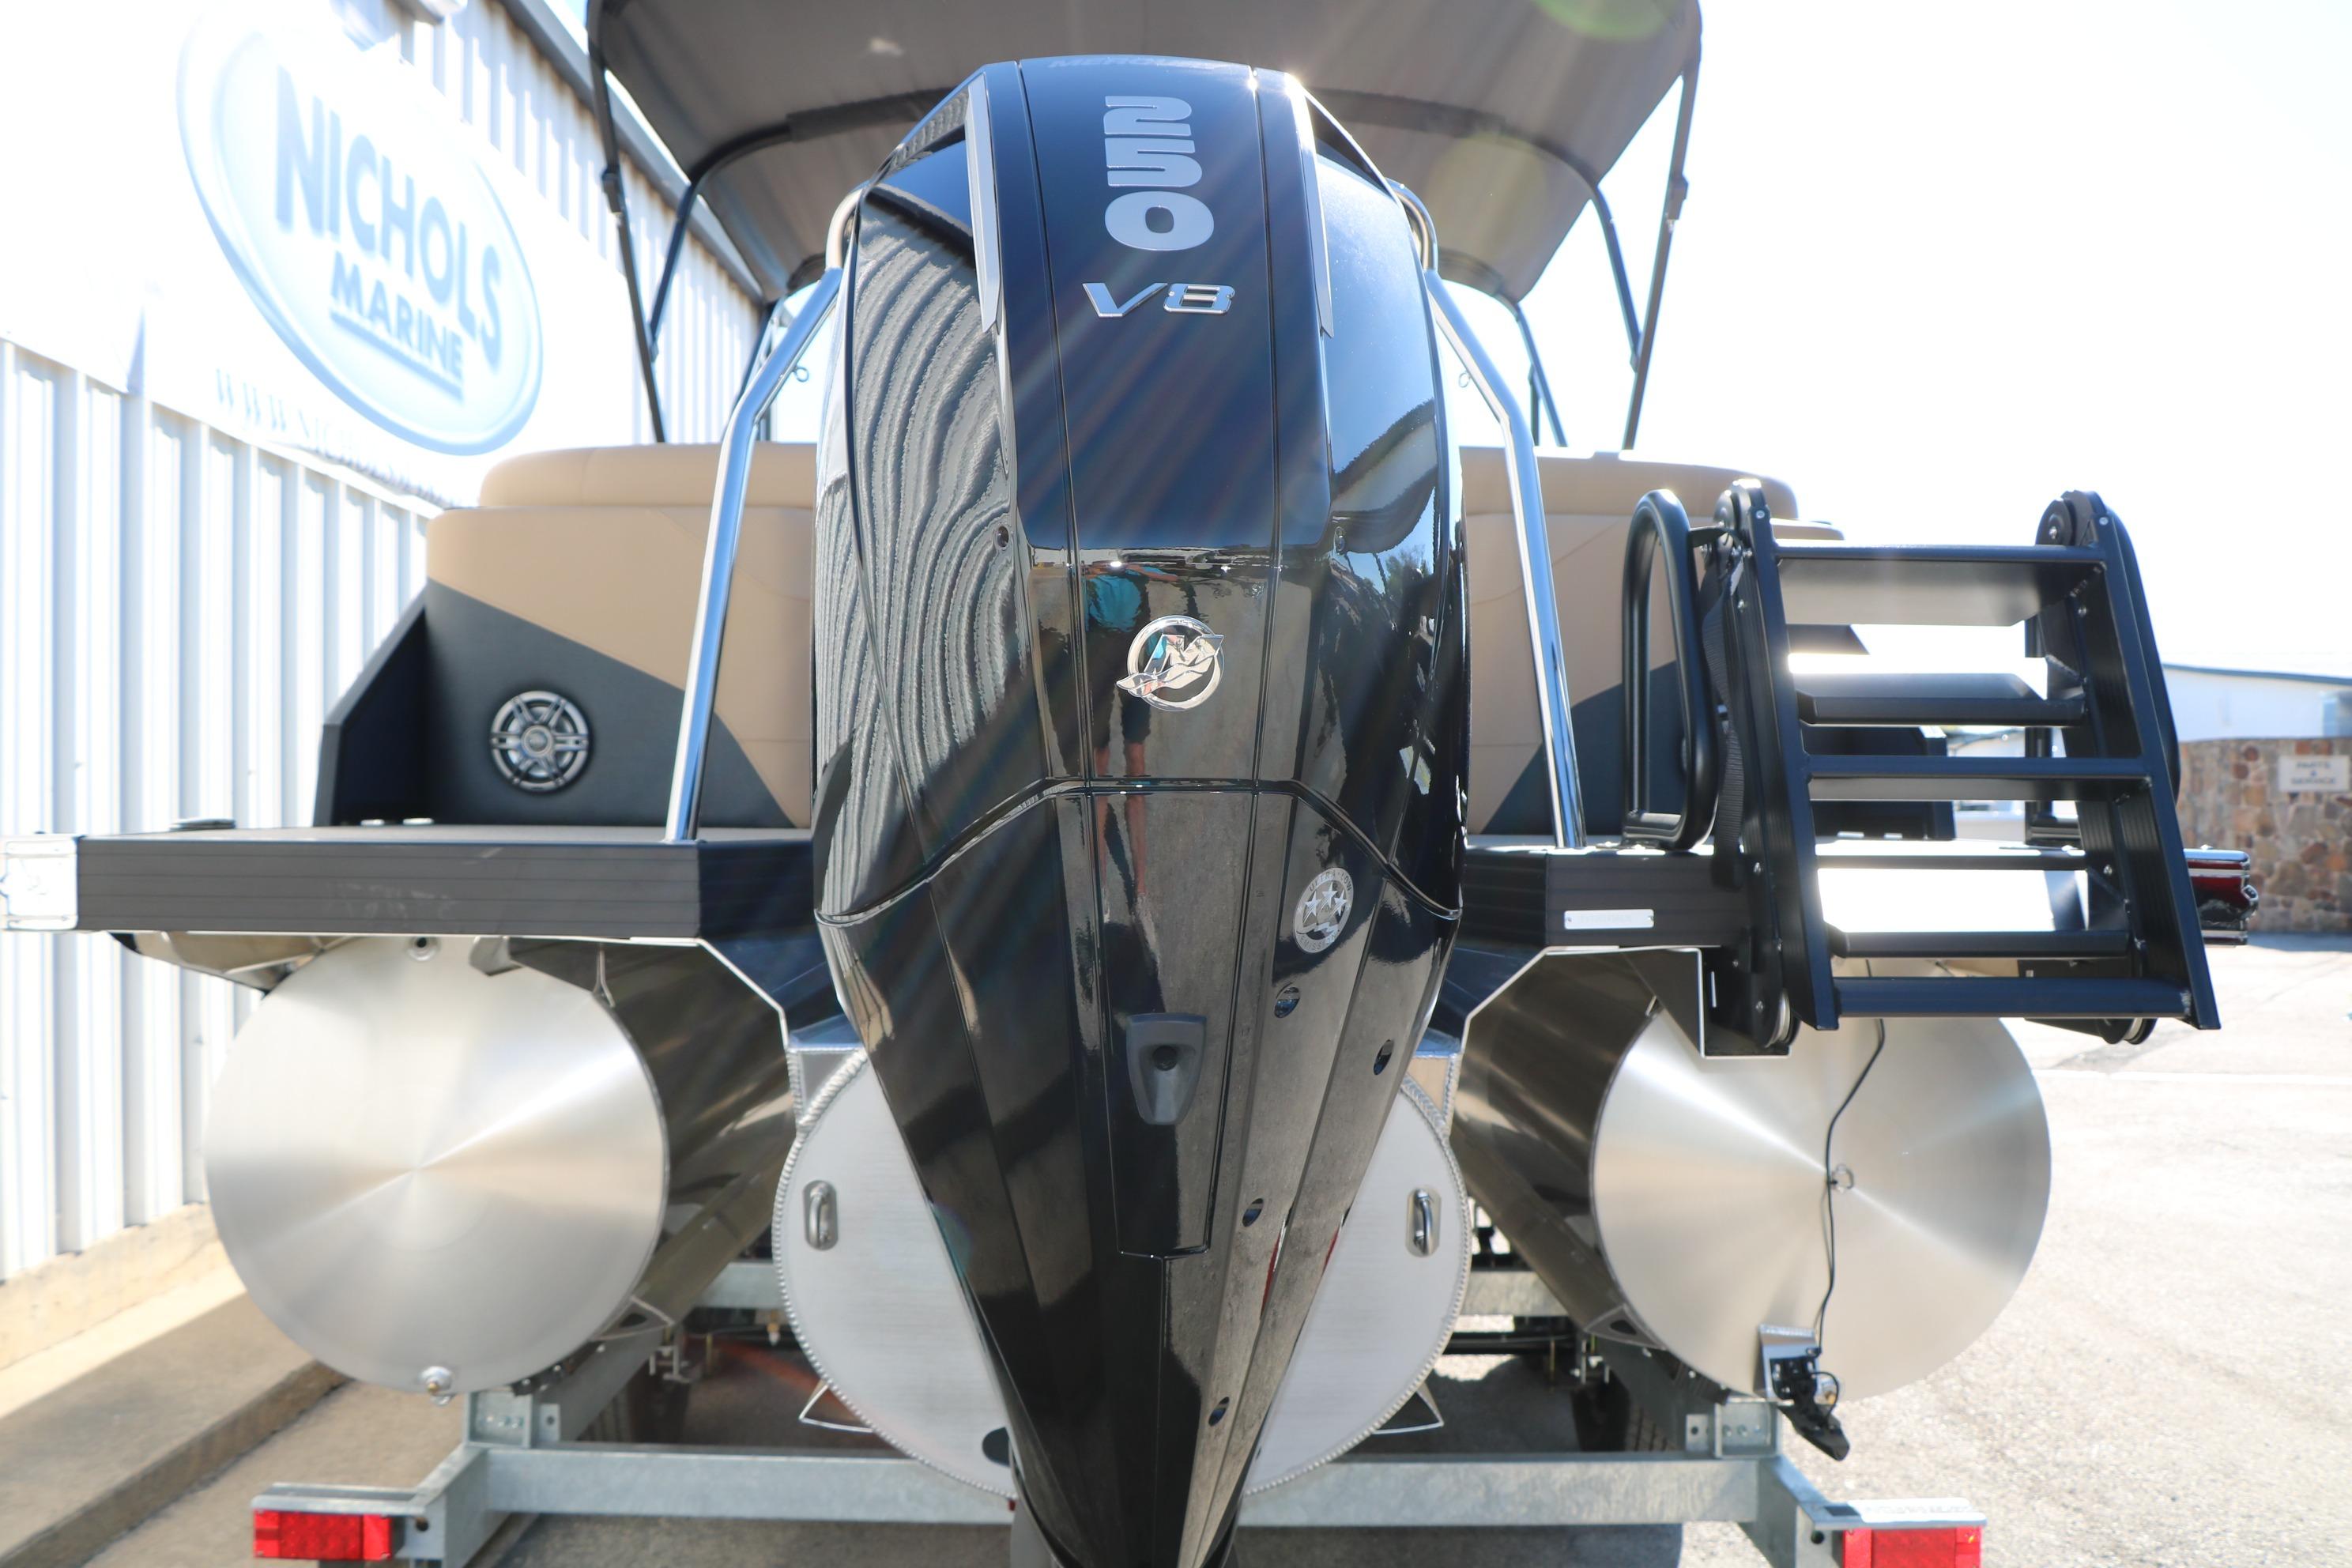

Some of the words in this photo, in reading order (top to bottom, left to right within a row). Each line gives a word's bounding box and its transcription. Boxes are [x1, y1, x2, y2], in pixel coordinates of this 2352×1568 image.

[274, 63, 503, 377] NICHOLS
[1103, 96, 1214, 251] 250
[330, 251, 465, 383] MARINE
[1082, 283, 1235, 317] V8
